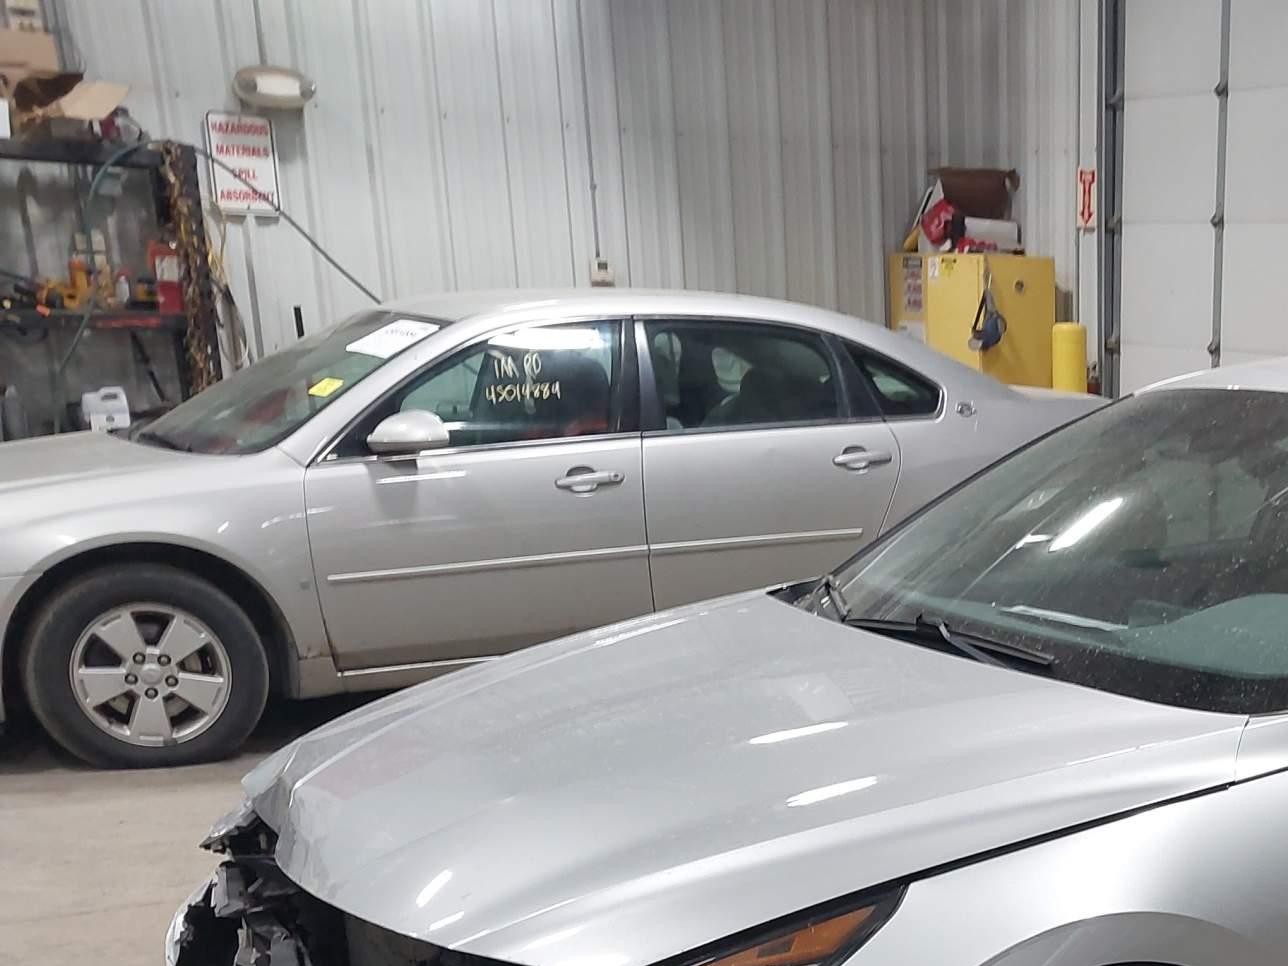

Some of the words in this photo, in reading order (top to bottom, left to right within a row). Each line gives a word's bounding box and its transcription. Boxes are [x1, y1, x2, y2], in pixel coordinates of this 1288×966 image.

[211, 121, 268, 136] HAZARDOUS
[215, 144, 270, 157] MATERIALS
[233, 167, 256, 180] SPILL
[523, 351, 542, 379] RD
